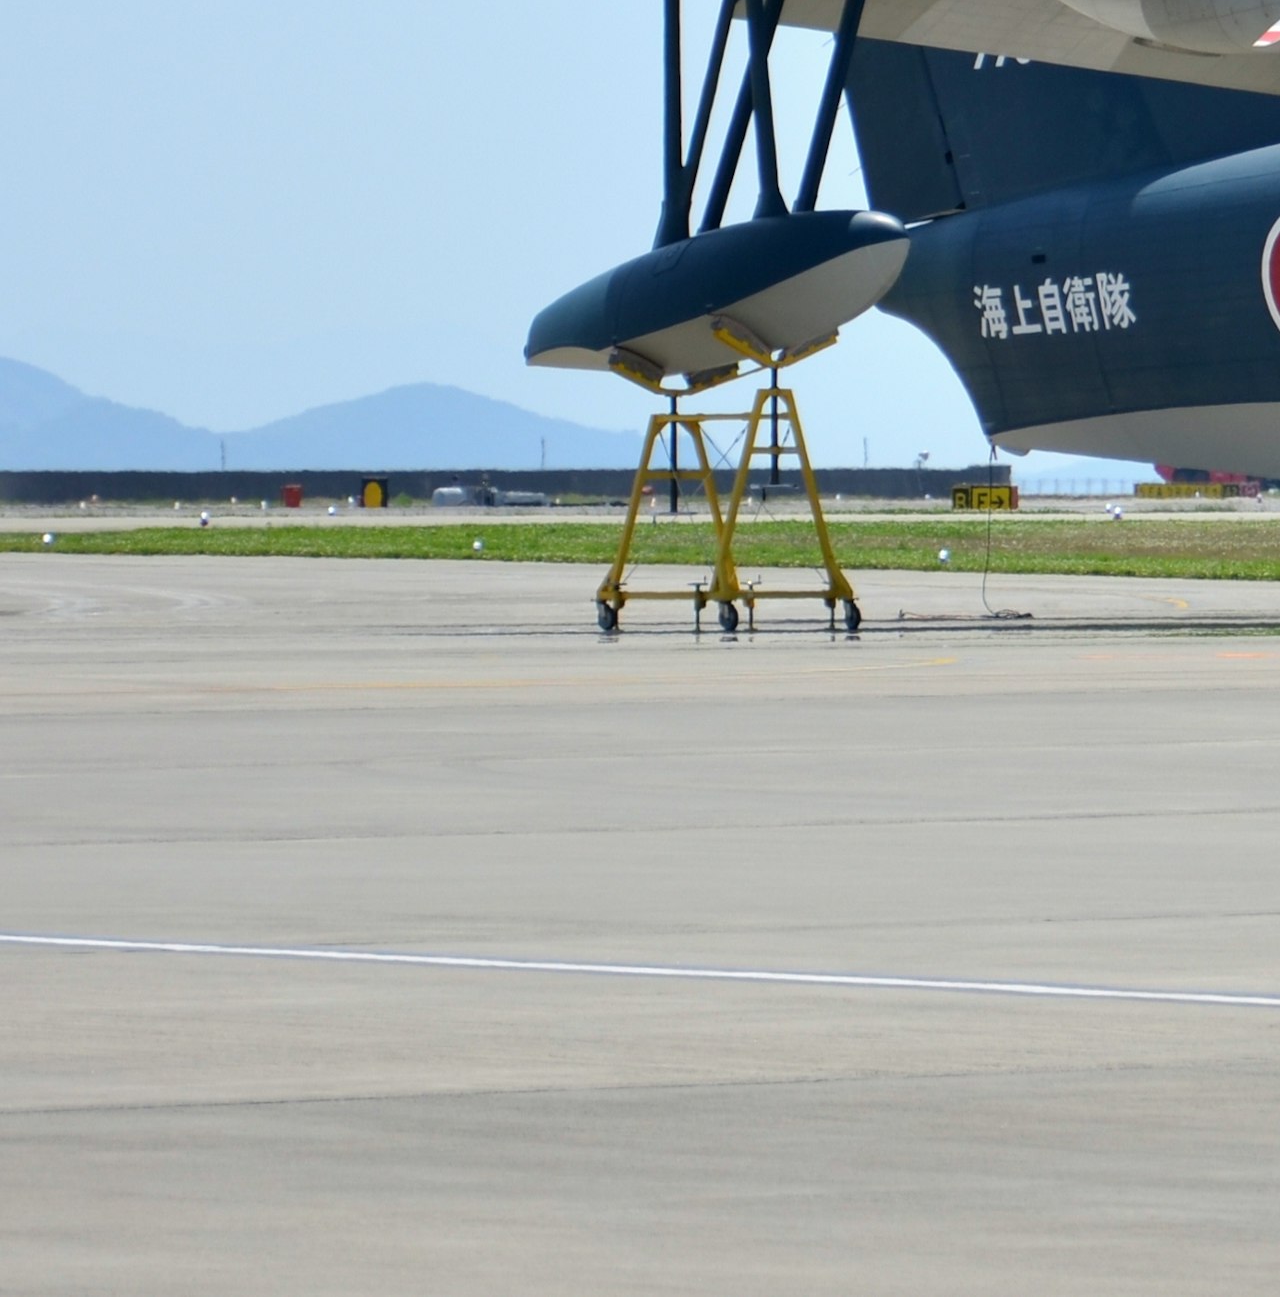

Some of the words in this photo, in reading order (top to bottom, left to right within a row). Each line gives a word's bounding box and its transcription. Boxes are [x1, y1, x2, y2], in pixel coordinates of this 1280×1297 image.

[973, 272, 1137, 339] 海上自衛隊
[978, 492, 988, 509] F
